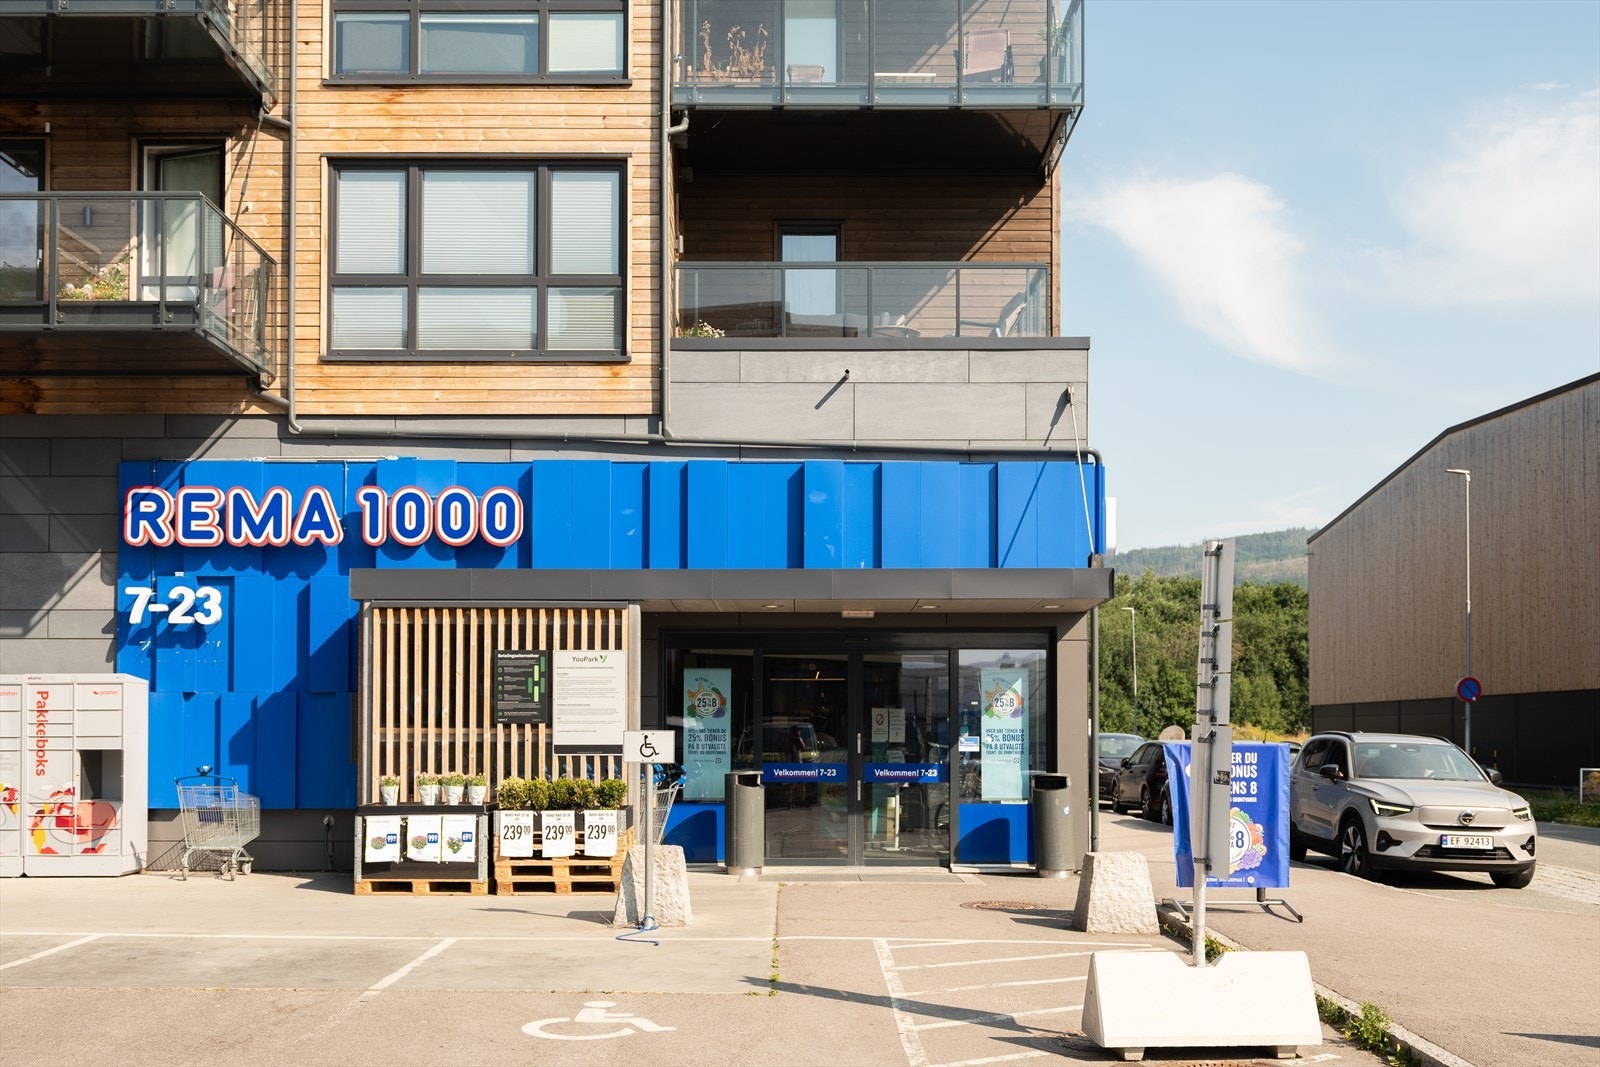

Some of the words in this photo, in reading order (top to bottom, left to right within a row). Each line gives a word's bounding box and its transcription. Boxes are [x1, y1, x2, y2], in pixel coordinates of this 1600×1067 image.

[124, 486, 344, 547] REMA
[356, 486, 524, 547] 1000
[124, 586, 222, 625] 7-23
[697, 698, 706, 707] 25
[712, 698, 717, 707] 8
[994, 698, 1004, 707] 25
[1010, 698, 1014, 707] 8
[36, 691, 49, 776] Pakkeboks
[1245, 752, 1257, 764] DU
[1231, 765, 1257, 778] ONUS
[1250, 781, 1257, 795] 8
[503, 825, 523, 840] 239
[524, 826, 531, 834] 00
[545, 825, 564, 840] 239
[566, 826, 572, 834] 00
[588, 825, 606, 839] 239
[1236, 831, 1244, 848] 8
